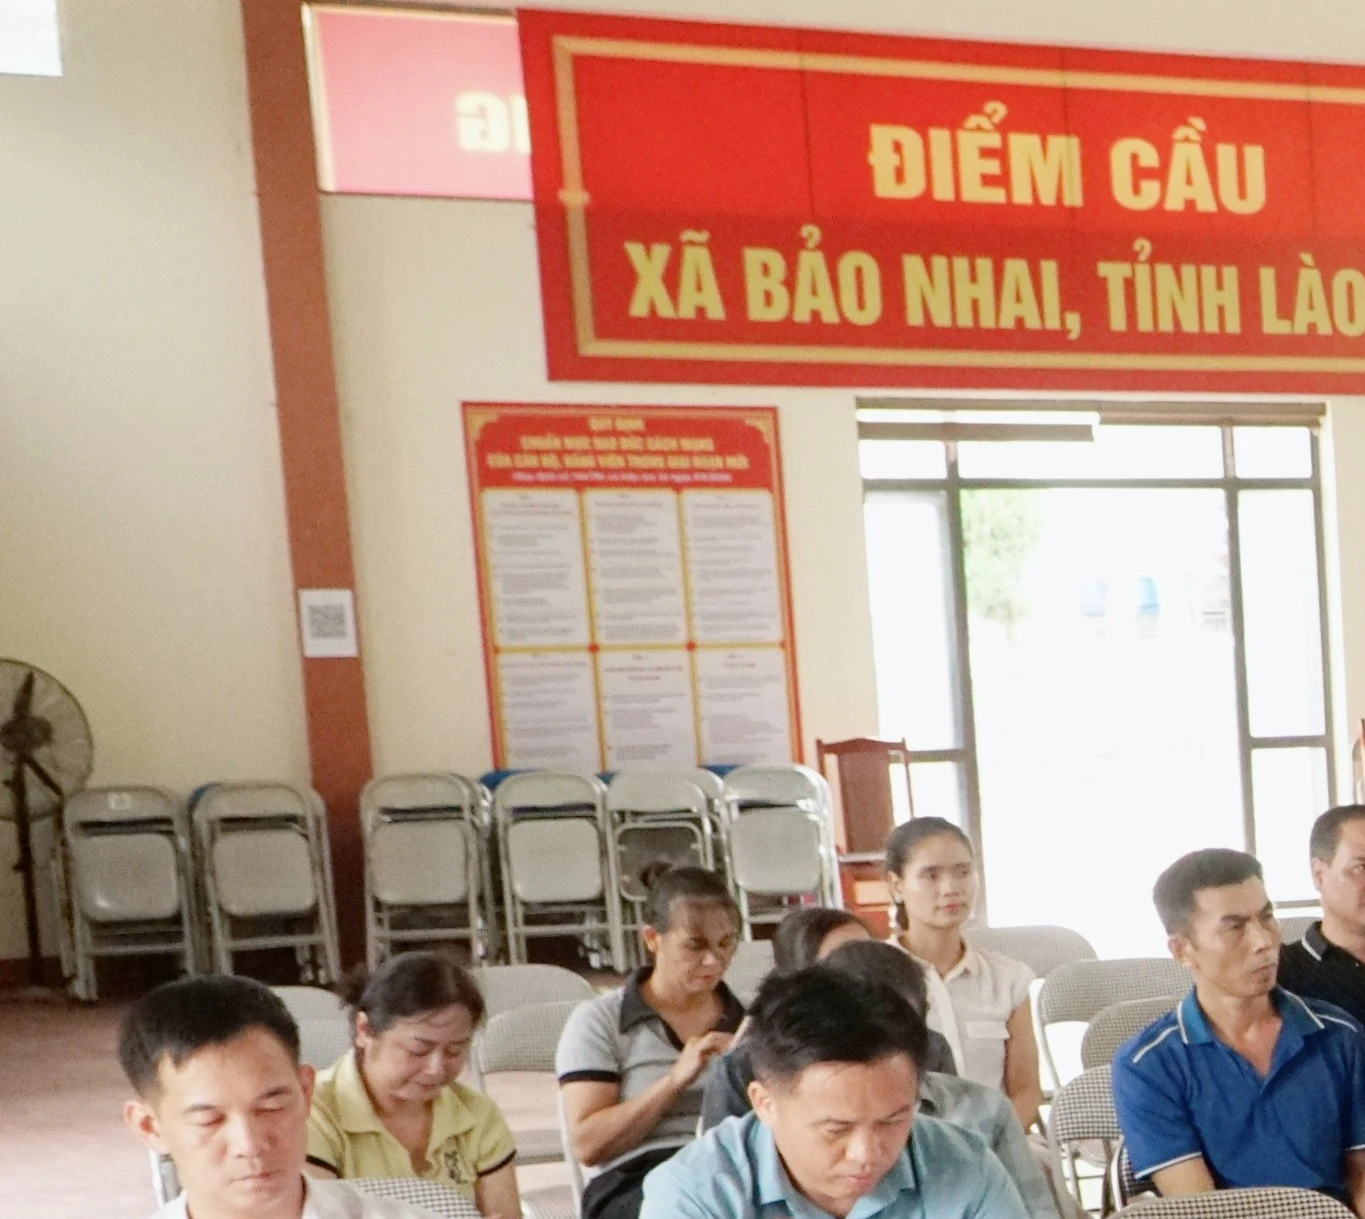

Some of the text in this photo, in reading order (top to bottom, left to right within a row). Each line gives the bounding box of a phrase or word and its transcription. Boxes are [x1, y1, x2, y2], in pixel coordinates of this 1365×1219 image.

[868, 101, 1267, 215] ĐIỂM CẦU
[624, 229, 726, 321] XÃ
[742, 224, 882, 327] BẢO
[902, 253, 1079, 341] NHAI,
[1097, 238, 1241, 334] TỈNH
